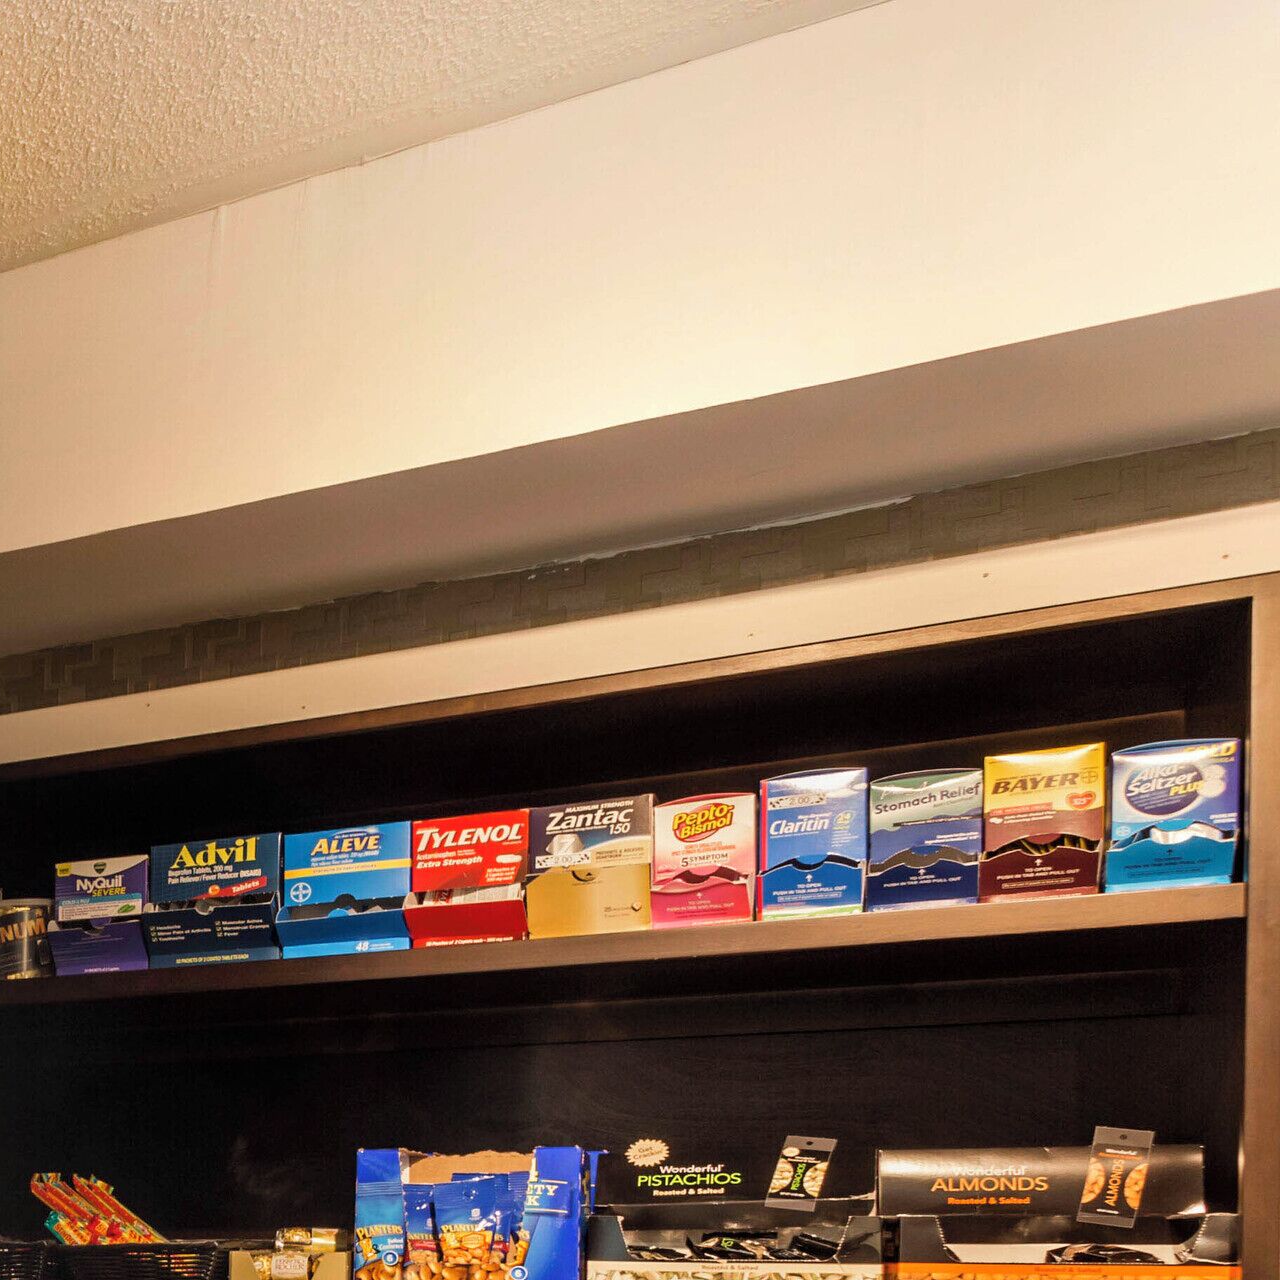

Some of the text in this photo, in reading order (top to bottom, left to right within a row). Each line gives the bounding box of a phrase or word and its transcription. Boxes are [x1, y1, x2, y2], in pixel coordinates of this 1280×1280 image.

[1132, 764, 1185, 783] Alka-
[991, 772, 1080, 796] BAYER
[1126, 771, 1198, 797] Seltzer
[874, 782, 981, 815] Stomach Relief
[564, 800, 634, 814] MAXIMUM STRENGTH
[545, 808, 634, 832] Zantac
[673, 804, 734, 831] Pepto-
[680, 812, 733, 839] Bismol
[609, 823, 631, 835] 150
[769, 819, 829, 836] Claritin
[310, 835, 380, 856] ALEVE
[416, 823, 523, 853] TYLENOL
[170, 836, 258, 869] Advil
[681, 853, 728, 868] 5 SYMPTOM
[416, 856, 484, 869] Extra Strength
[76, 875, 124, 894] NyQuil
[93, 886, 127, 897] SEVERE
[231, 881, 260, 893] Tablets
[355, 941, 370, 951] 48
[659, 1164, 723, 1173] Wonderful
[952, 1164, 1028, 1177] Wonderful
[637, 1173, 742, 1187] PISTACHIOS
[930, 1177, 1049, 1193] ALMONDS
[1104, 1159, 1125, 1207] ALMONDS
[653, 1188, 687, 1197] Roasted
[697, 1187, 725, 1195] Salted
[947, 1196, 1031, 1206] Roasted & Salted
[356, 1224, 404, 1240] PLANTERS
